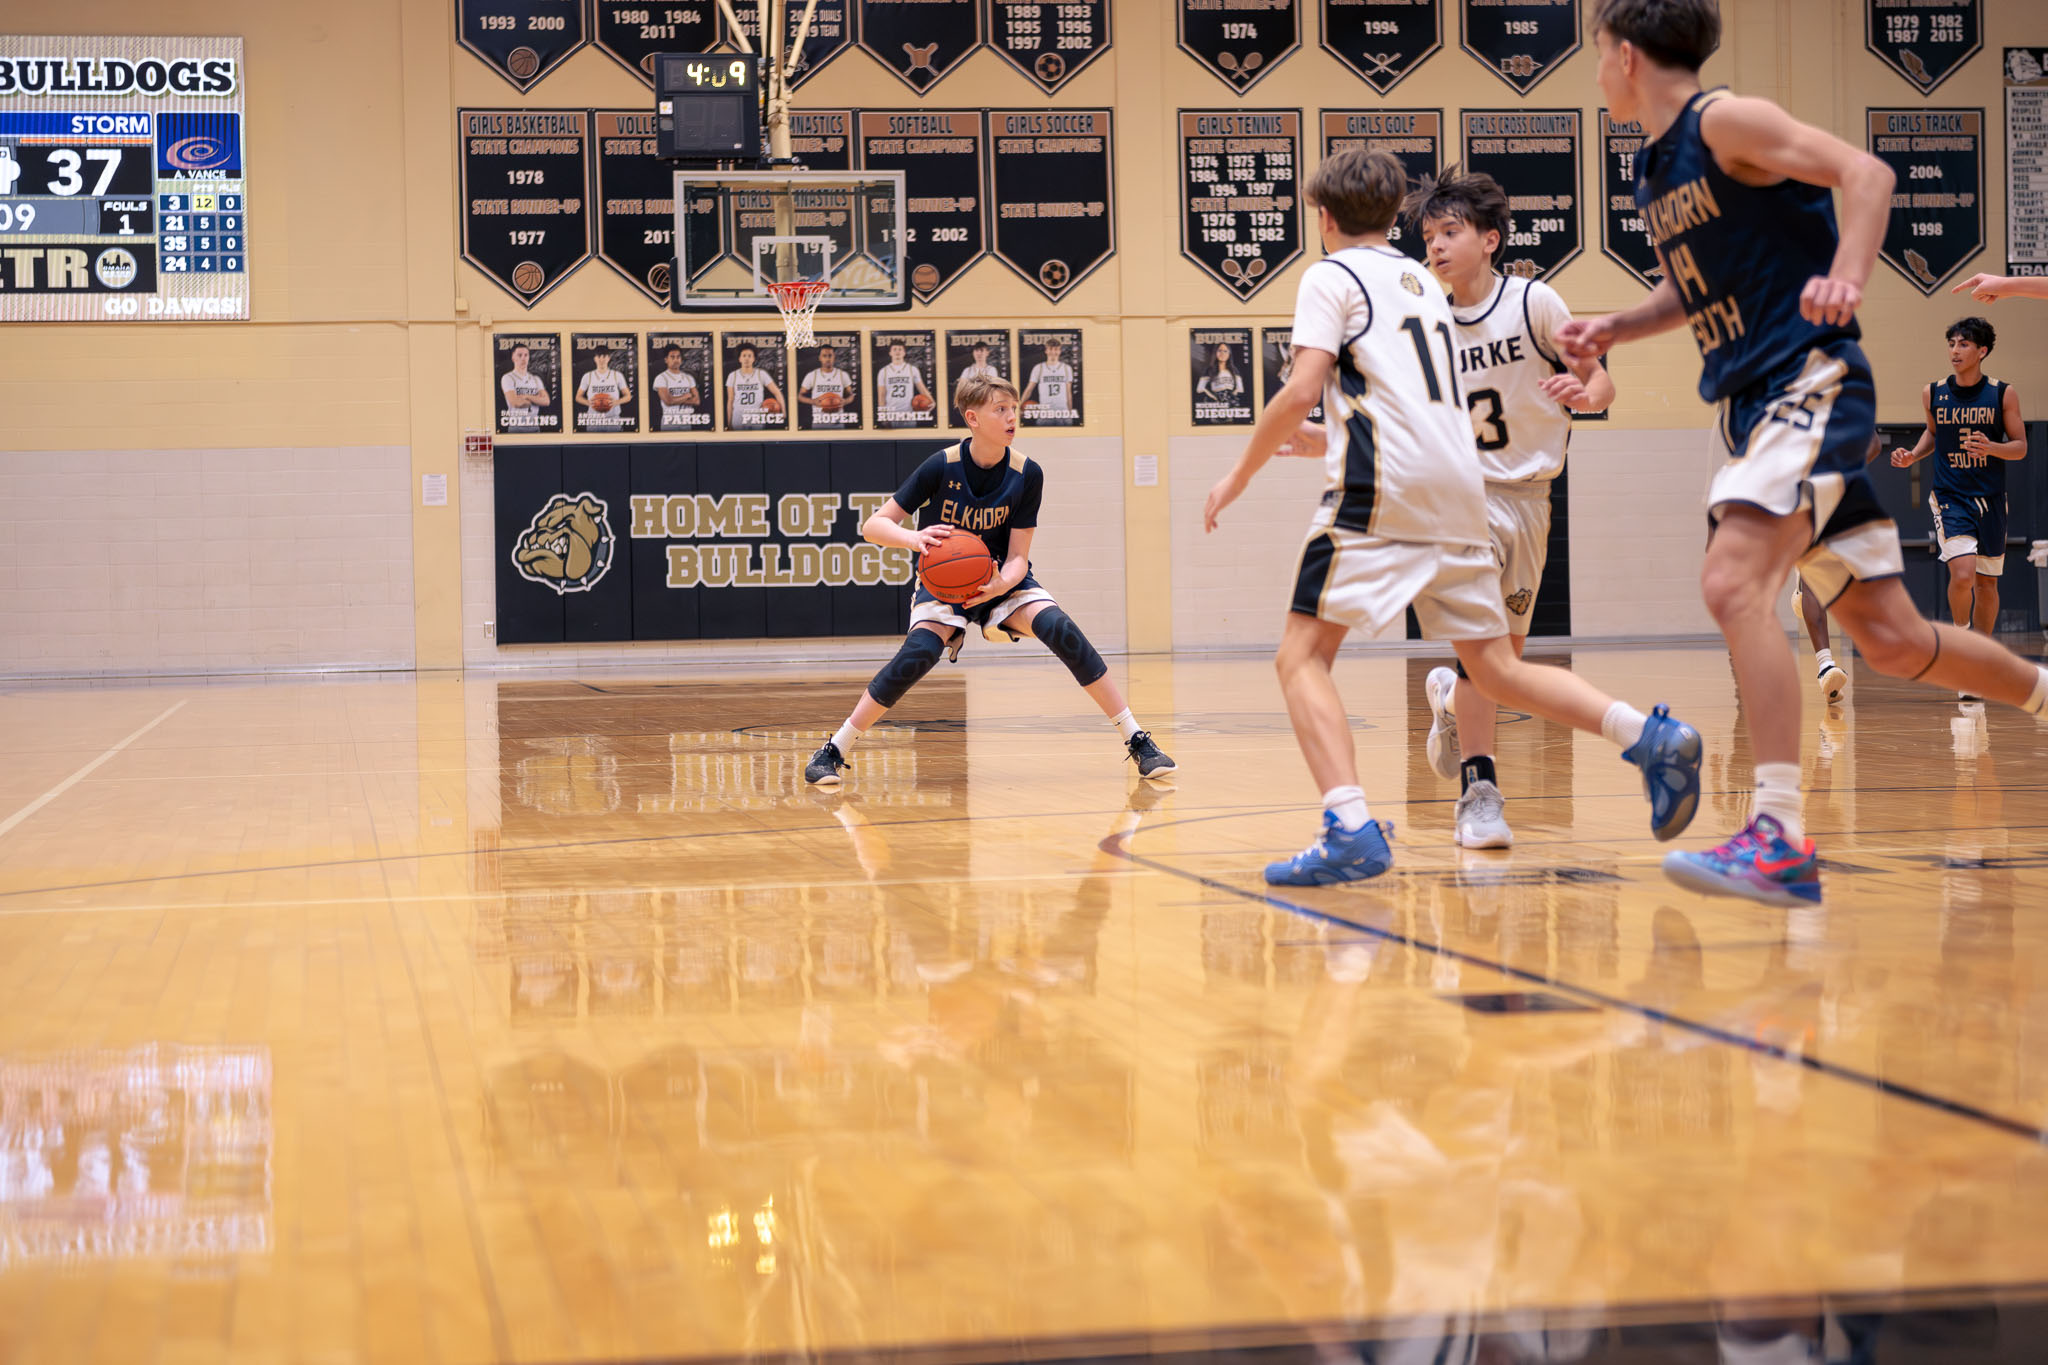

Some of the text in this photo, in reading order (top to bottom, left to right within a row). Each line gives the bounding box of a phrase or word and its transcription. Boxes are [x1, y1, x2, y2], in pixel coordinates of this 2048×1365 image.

[612, 10, 701, 24] 1980 1984
[1006, 6, 1092, 18] 1989 1993
[480, 16, 565, 30] 1993 2000
[1006, 21, 1092, 34] 1995 1996
[1364, 21, 1399, 34] 1994
[1504, 21, 1539, 34] 1985
[1886, 15, 1963, 28] 1979 1982
[640, 26, 676, 39] 2011
[1222, 23, 1258, 39] 1974
[1886, 30, 1963, 43] 1987 2015
[1006, 36, 1092, 49] 1997 2002
[71, 115, 149, 134] STORM
[469, 116, 580, 135] GIRLS BASKETBALL
[616, 116, 656, 134] VOLLE
[889, 116, 954, 134] SOFTBALL
[1006, 116, 1094, 134] GIRLS SOCCER
[1197, 117, 1282, 134] GIRLS TENNIS
[1347, 116, 1416, 134] GIRLS GOLF
[1469, 116, 1572, 134] GIRLS CROSS COUNTRY
[1888, 116, 1964, 132] GIRLS TRACK
[470, 139, 579, 155] STATE CHAMPIONS
[604, 140, 641, 155] STATE
[869, 139, 974, 154] STATE CHAMPIONS
[998, 139, 1102, 154] STATE CHAMPIONS
[1189, 139, 1292, 154] STATE CHAMPIONS
[1472, 139, 1572, 154] STATE CHAMPIONS
[1878, 138, 1974, 152] STATE CHAMPIONS
[1190, 154, 1292, 168] 1974 1975 1981
[46, 149, 122, 196] 37
[188, 170, 226, 180] VANCE
[507, 170, 544, 184] 1978
[1190, 168, 1292, 182] 1984 1992 1993
[1910, 166, 1942, 179] 2004
[1209, 183, 1274, 197] 1994 1997
[168, 196, 234, 210] 3 12 0
[738, 189, 771, 208] GIRLS
[908, 198, 976, 213] RUNNER-UP
[1192, 197, 1294, 212] STATE RUNNER-UP
[1509, 196, 1572, 210] RUNNER-UP
[1912, 194, 1974, 208] RUNNER-UP
[104, 202, 148, 211] FOULS
[472, 198, 581, 215] STATE RUNNER-UP
[607, 200, 643, 215] STATE
[1001, 202, 1104, 218] STATE RUNNER-UP
[119, 214, 134, 234] 1
[166, 216, 235, 230] 21 5 0
[740, 214, 776, 228] STATE
[1201, 213, 1284, 227] 1976 1979
[1532, 219, 1565, 232] 2001
[932, 229, 968, 242] 2002
[1202, 228, 1285, 242] 1980 1982
[1912, 222, 1943, 236] 1998
[164, 236, 236, 251] 35 5 0
[509, 230, 546, 245] 1977
[1507, 233, 1541, 245] 2003
[1226, 244, 1261, 257] 1996
[166, 257, 236, 271] 24 4 0
[2010, 264, 2048, 276] TRA
[1669, 243, 1708, 304] 14
[104, 298, 242, 314] GO DAWGS!
[1401, 316, 1461, 410] 11
[891, 384, 906, 398] 23
[1048, 384, 1060, 397] 13
[740, 392, 756, 405] 20
[664, 414, 710, 425] PARKS
[742, 413, 784, 424] PRICE
[812, 412, 858, 424] ROPER
[877, 411, 933, 421] RUMMEL
[1024, 410, 1079, 419] SVOBODA
[1195, 408, 1250, 418] DIEGUEZ
[1467, 388, 1509, 451] 3
[1936, 407, 1995, 425] ELKHORN
[500, 416, 558, 426] COLLINS
[577, 417, 635, 426] MICHELETTI
[630, 494, 770, 538] HOME
[778, 493, 841, 538] OF
[666, 543, 913, 588] BULLDOGS
